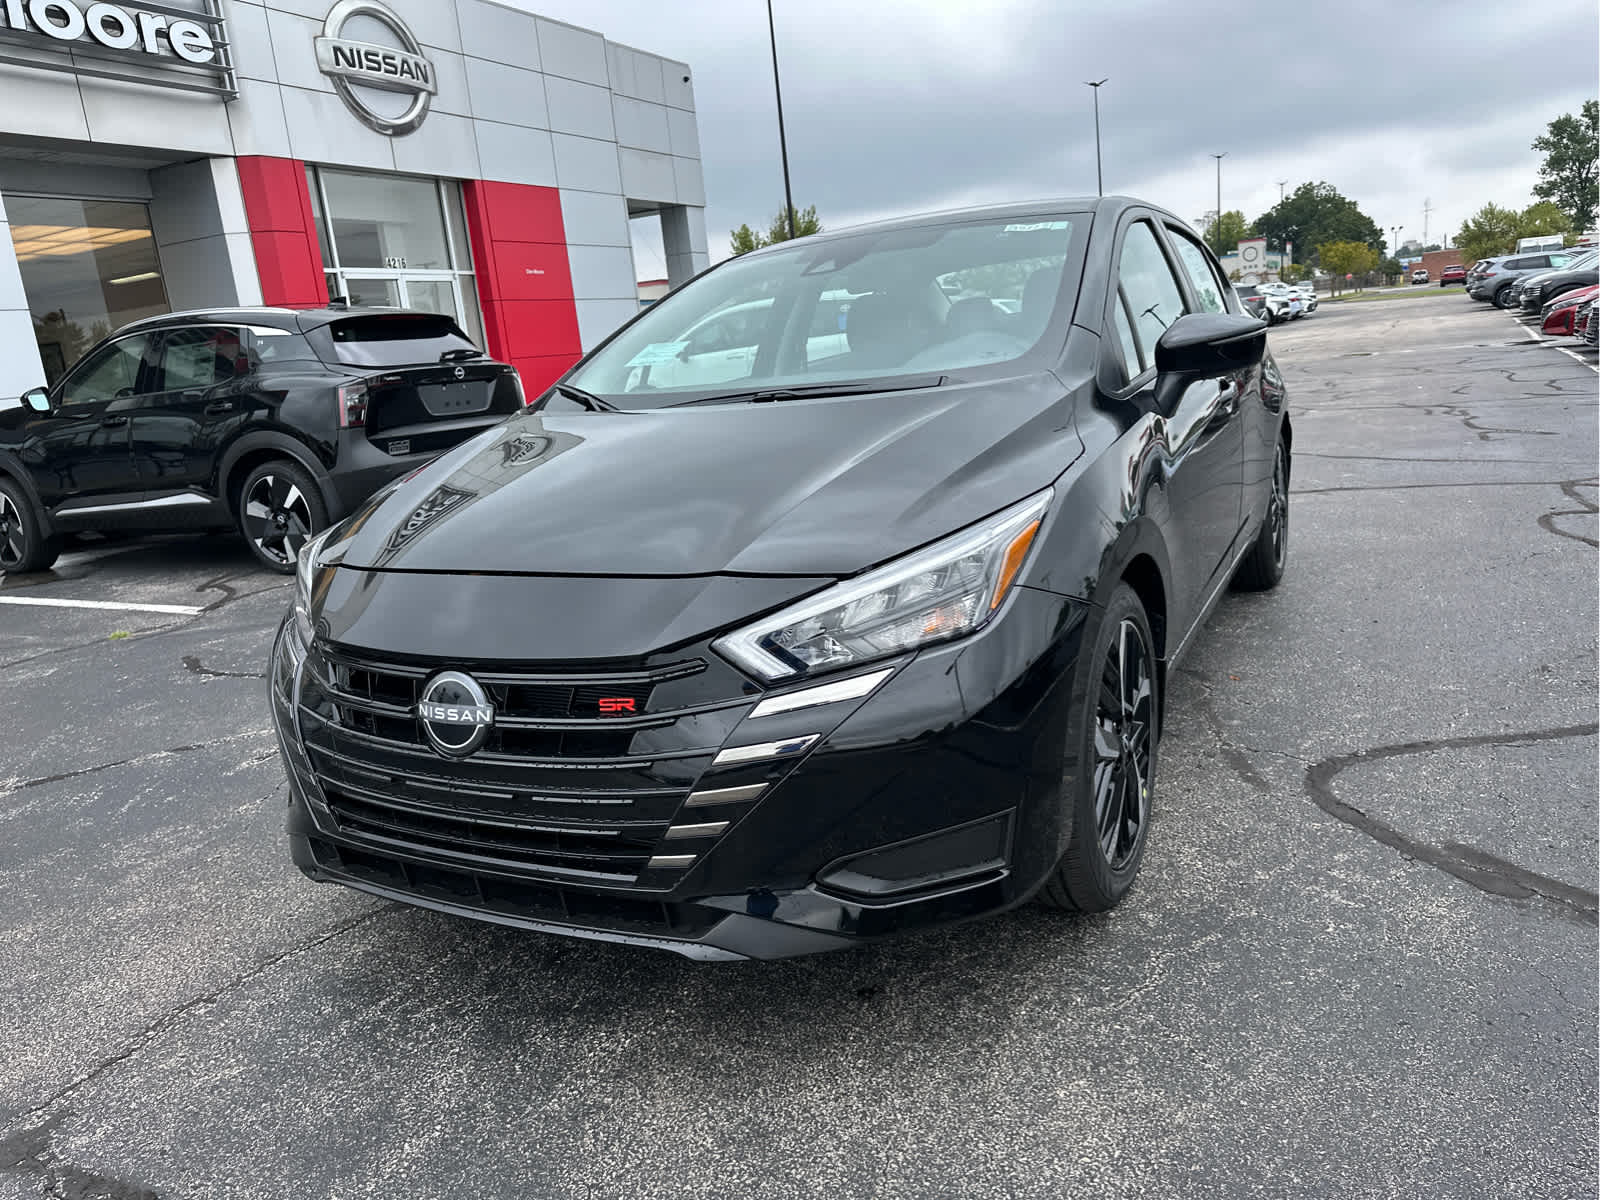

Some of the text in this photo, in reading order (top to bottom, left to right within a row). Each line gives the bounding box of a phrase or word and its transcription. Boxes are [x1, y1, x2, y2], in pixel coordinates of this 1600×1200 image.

[332, 45, 429, 84] NISSAN
[418, 703, 491, 722] NISSAN
[598, 698, 636, 711] SR
